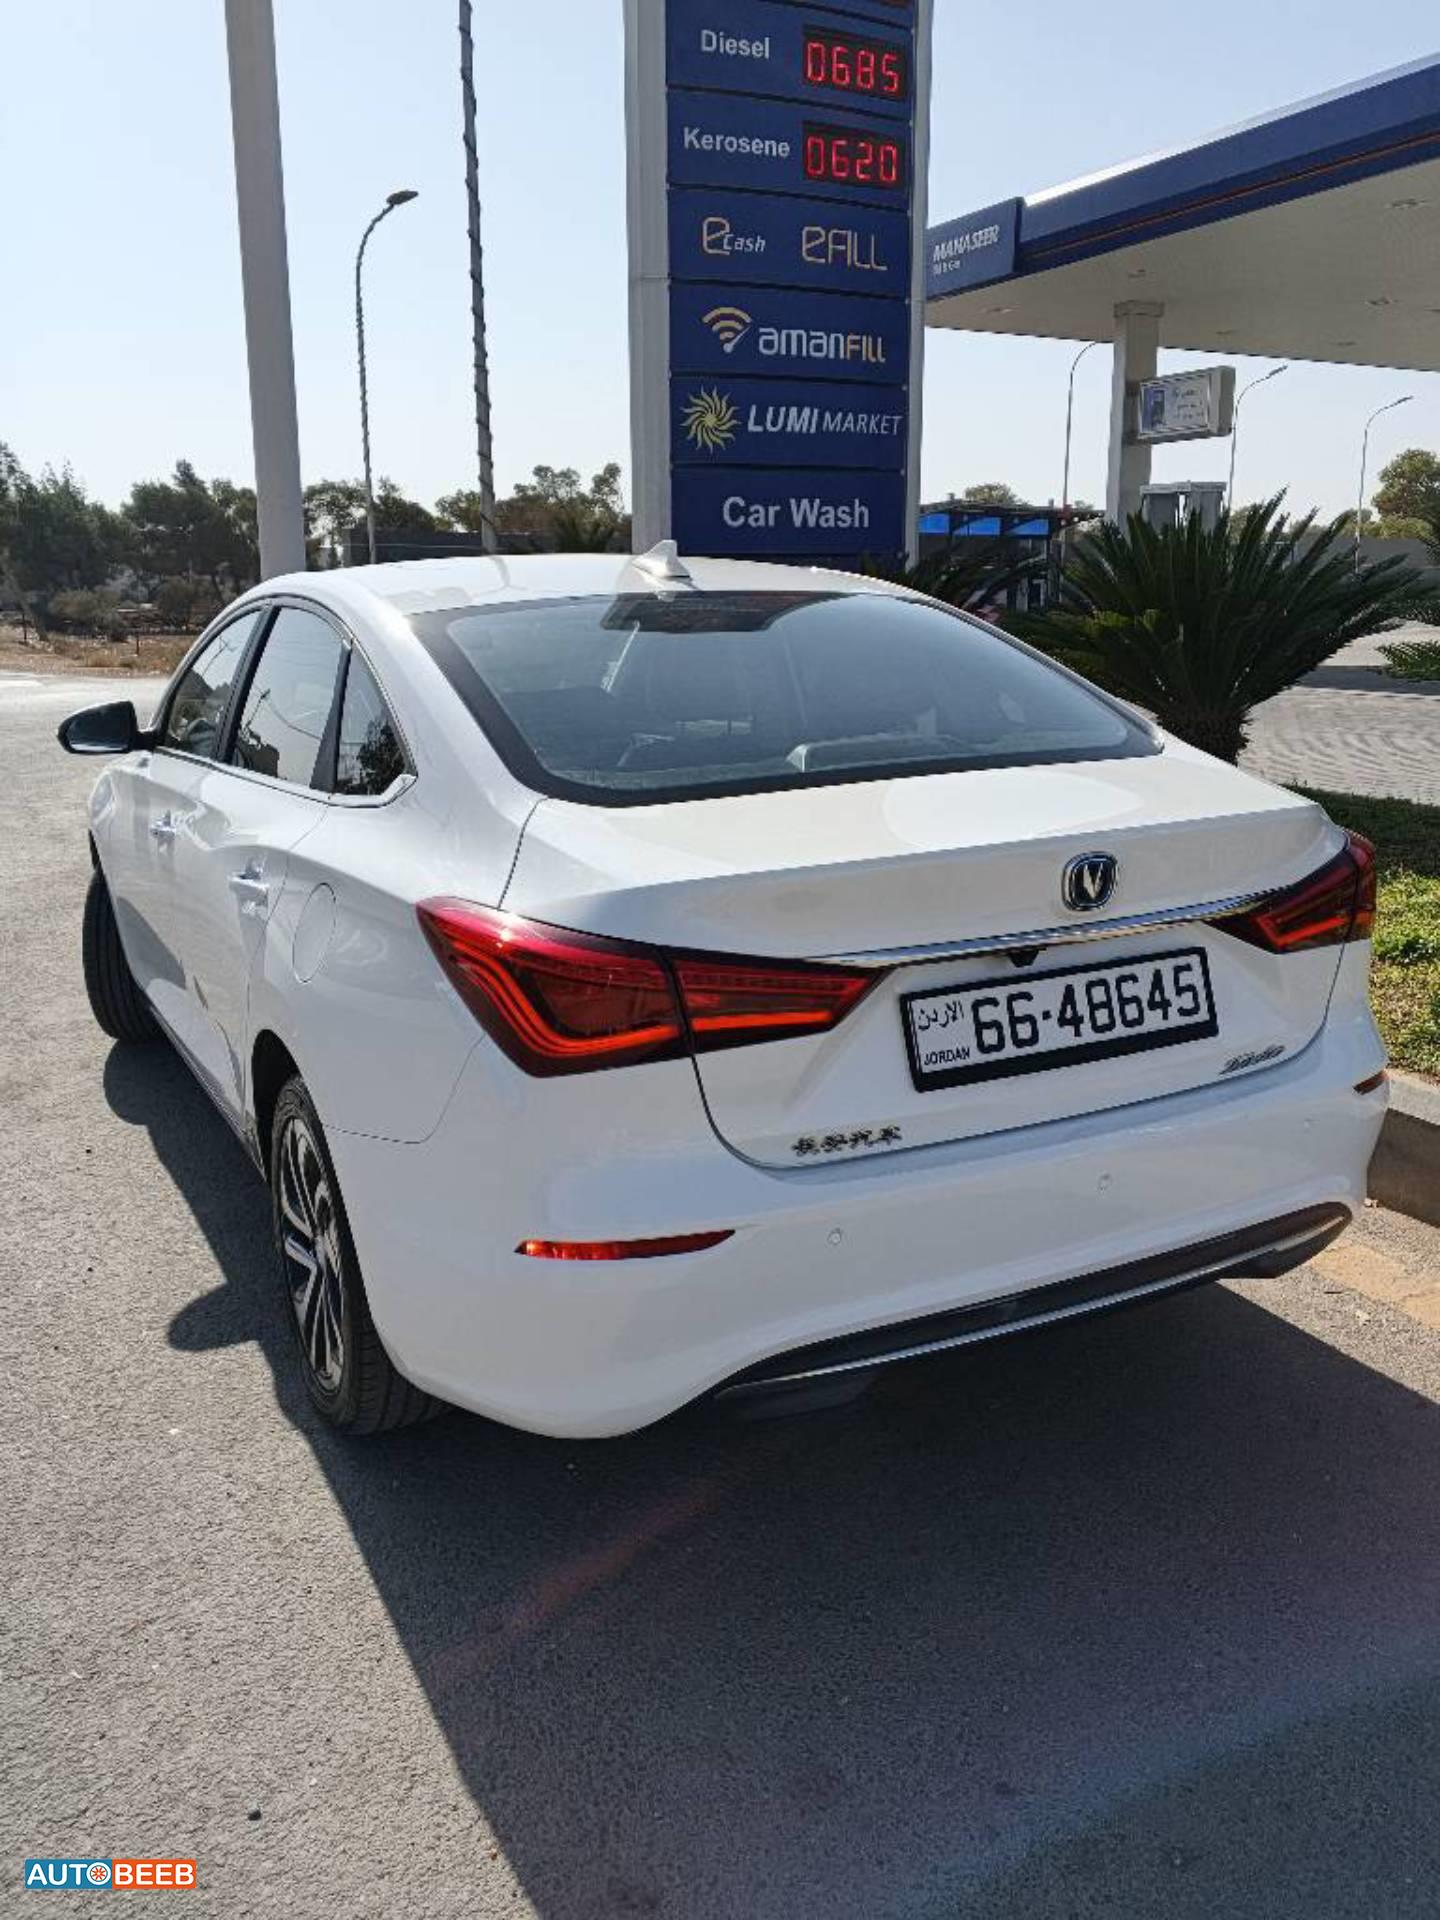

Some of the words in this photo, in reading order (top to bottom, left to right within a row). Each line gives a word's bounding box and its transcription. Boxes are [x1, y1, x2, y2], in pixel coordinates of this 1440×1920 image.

[701, 29, 770, 59] Diesel
[806, 42, 899, 93] 0685
[683, 126, 791, 158] Kerosene
[806, 136, 898, 182] 0620
[747, 404, 819, 434] LUMI
[822, 410, 903, 436] MARKET
[722, 496, 780, 527] Car
[789, 498, 870, 528] Wash
[924, 1047, 970, 1066] JORDAN
